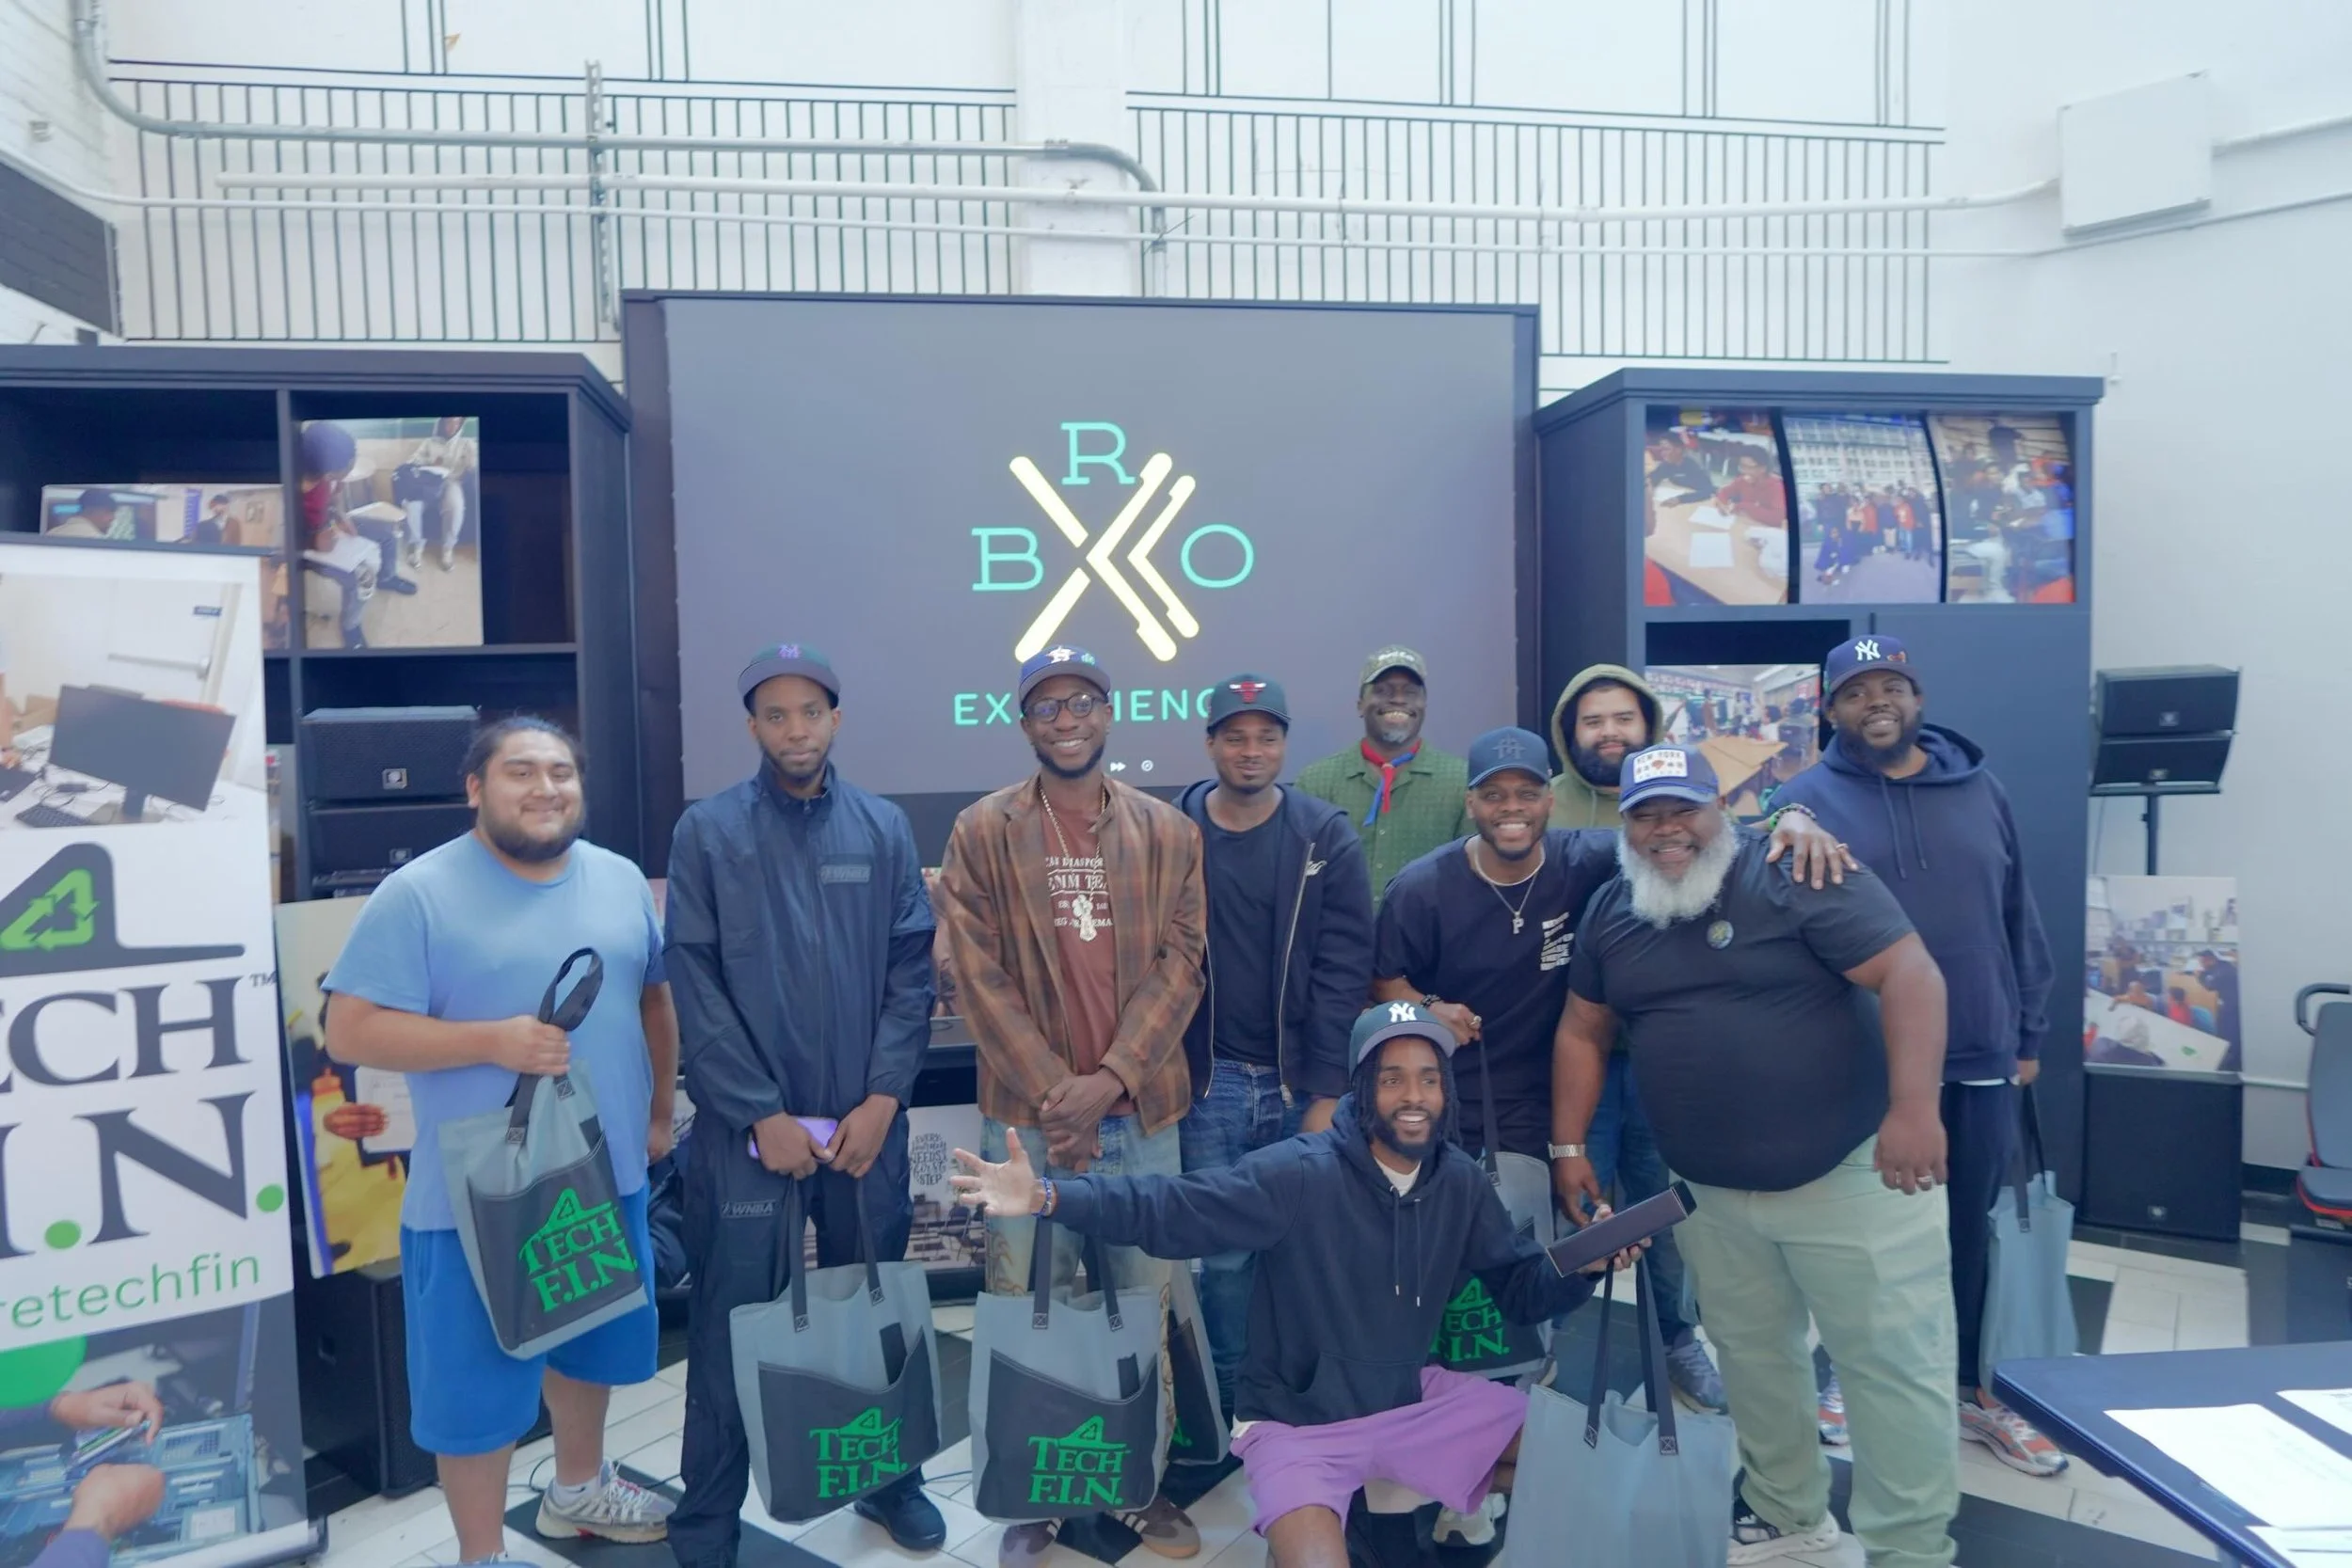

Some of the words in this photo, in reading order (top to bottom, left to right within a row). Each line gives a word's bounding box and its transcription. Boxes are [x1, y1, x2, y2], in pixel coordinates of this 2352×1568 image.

[0, 975, 253, 1093] CH
[518, 1210, 622, 1275] TECH
[0, 1252, 261, 1329] etechfin
[1027, 1435, 1123, 1473] TECH
[1027, 1474, 1125, 1507] F.I.N.
